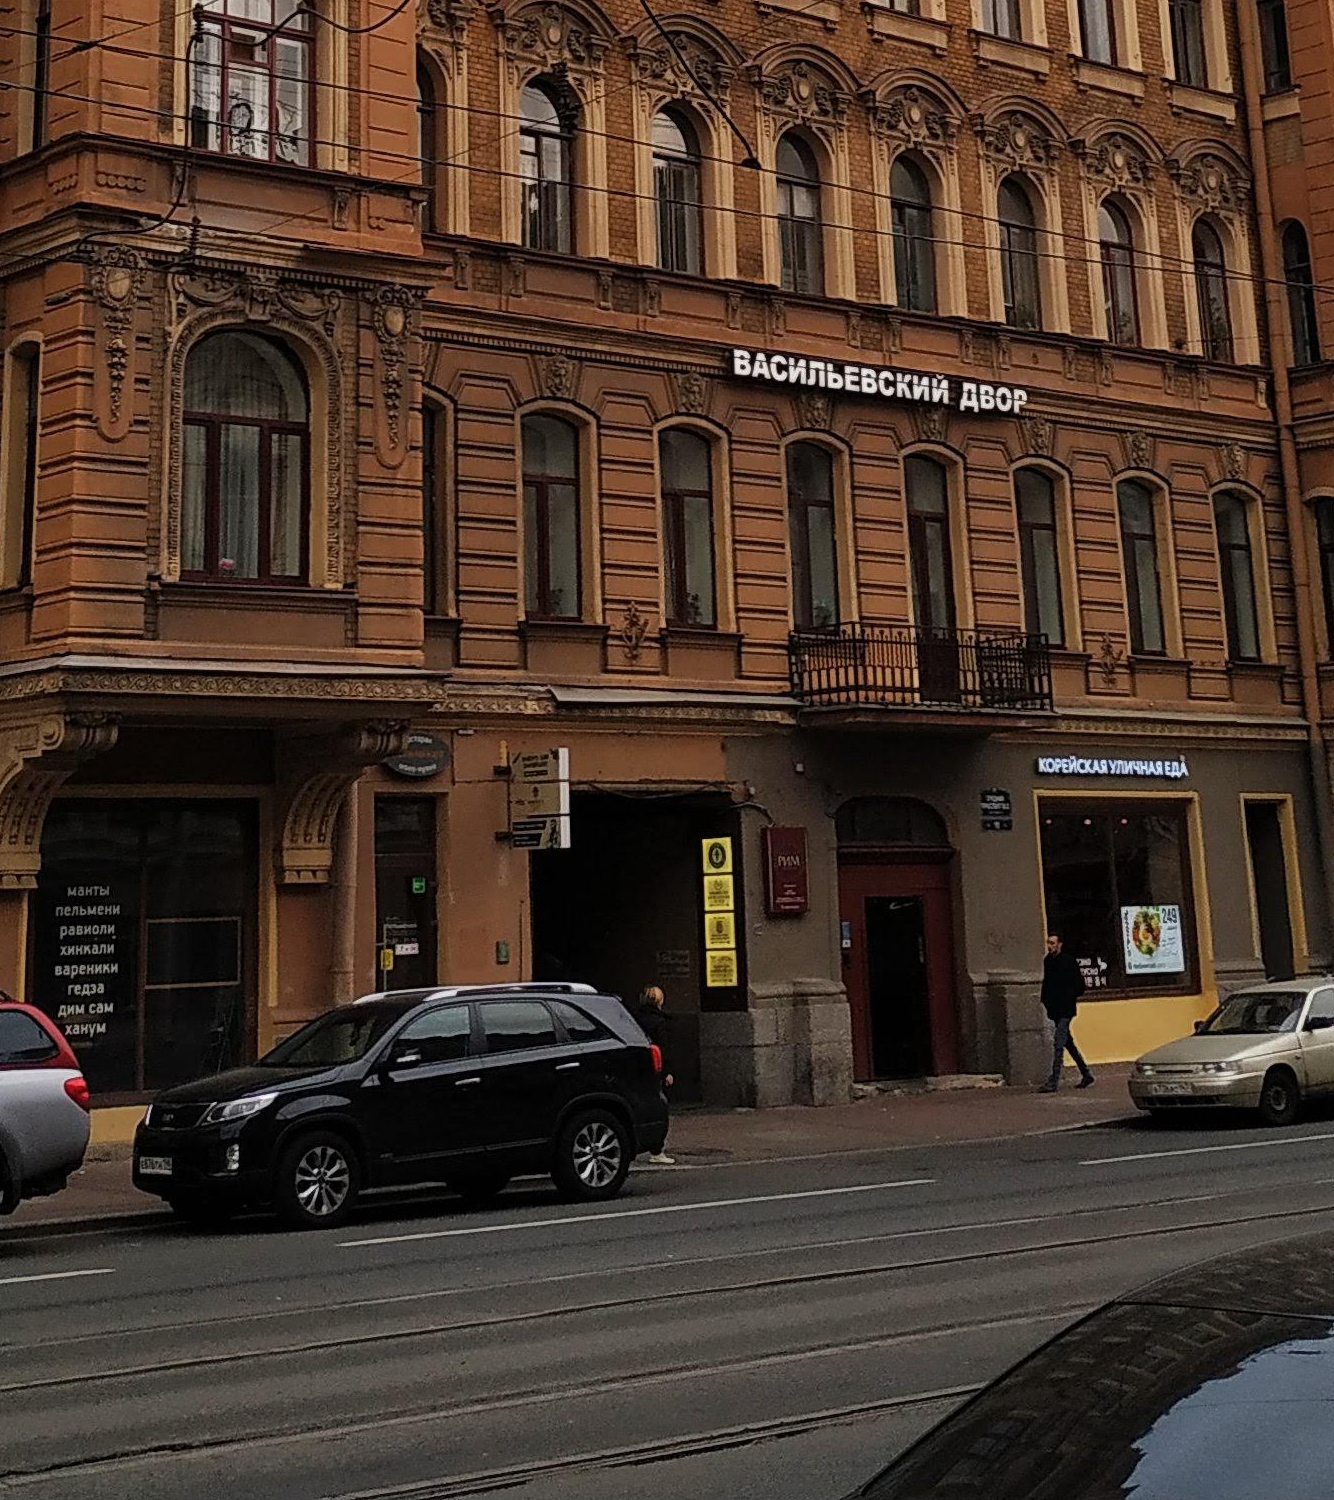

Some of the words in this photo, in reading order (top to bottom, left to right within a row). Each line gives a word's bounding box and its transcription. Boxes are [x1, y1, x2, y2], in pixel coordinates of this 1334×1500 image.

[732, 349, 950, 404] ВАСИЛЬЕВСКИЙ
[959, 382, 1028, 414] ДВОР
[1037, 755, 1108, 775] КОРЕЙСКАЯ
[1108, 760, 1163, 776] УЛИЧНАЯ
[1164, 759, 1189, 778] ЕДА
[67, 885, 110, 897] манты
[55, 904, 121, 917] пельмени
[1161, 907, 1178, 924] 249
[59, 924, 115, 940] равиоли
[59, 943, 115, 956] хинкали
[54, 963, 119, 980] вареники
[67, 983, 105, 997] гедза
[58, 1004, 85, 1017] дим
[88, 1002, 114, 1014] сам
[65, 1022, 107, 1039] ханум
